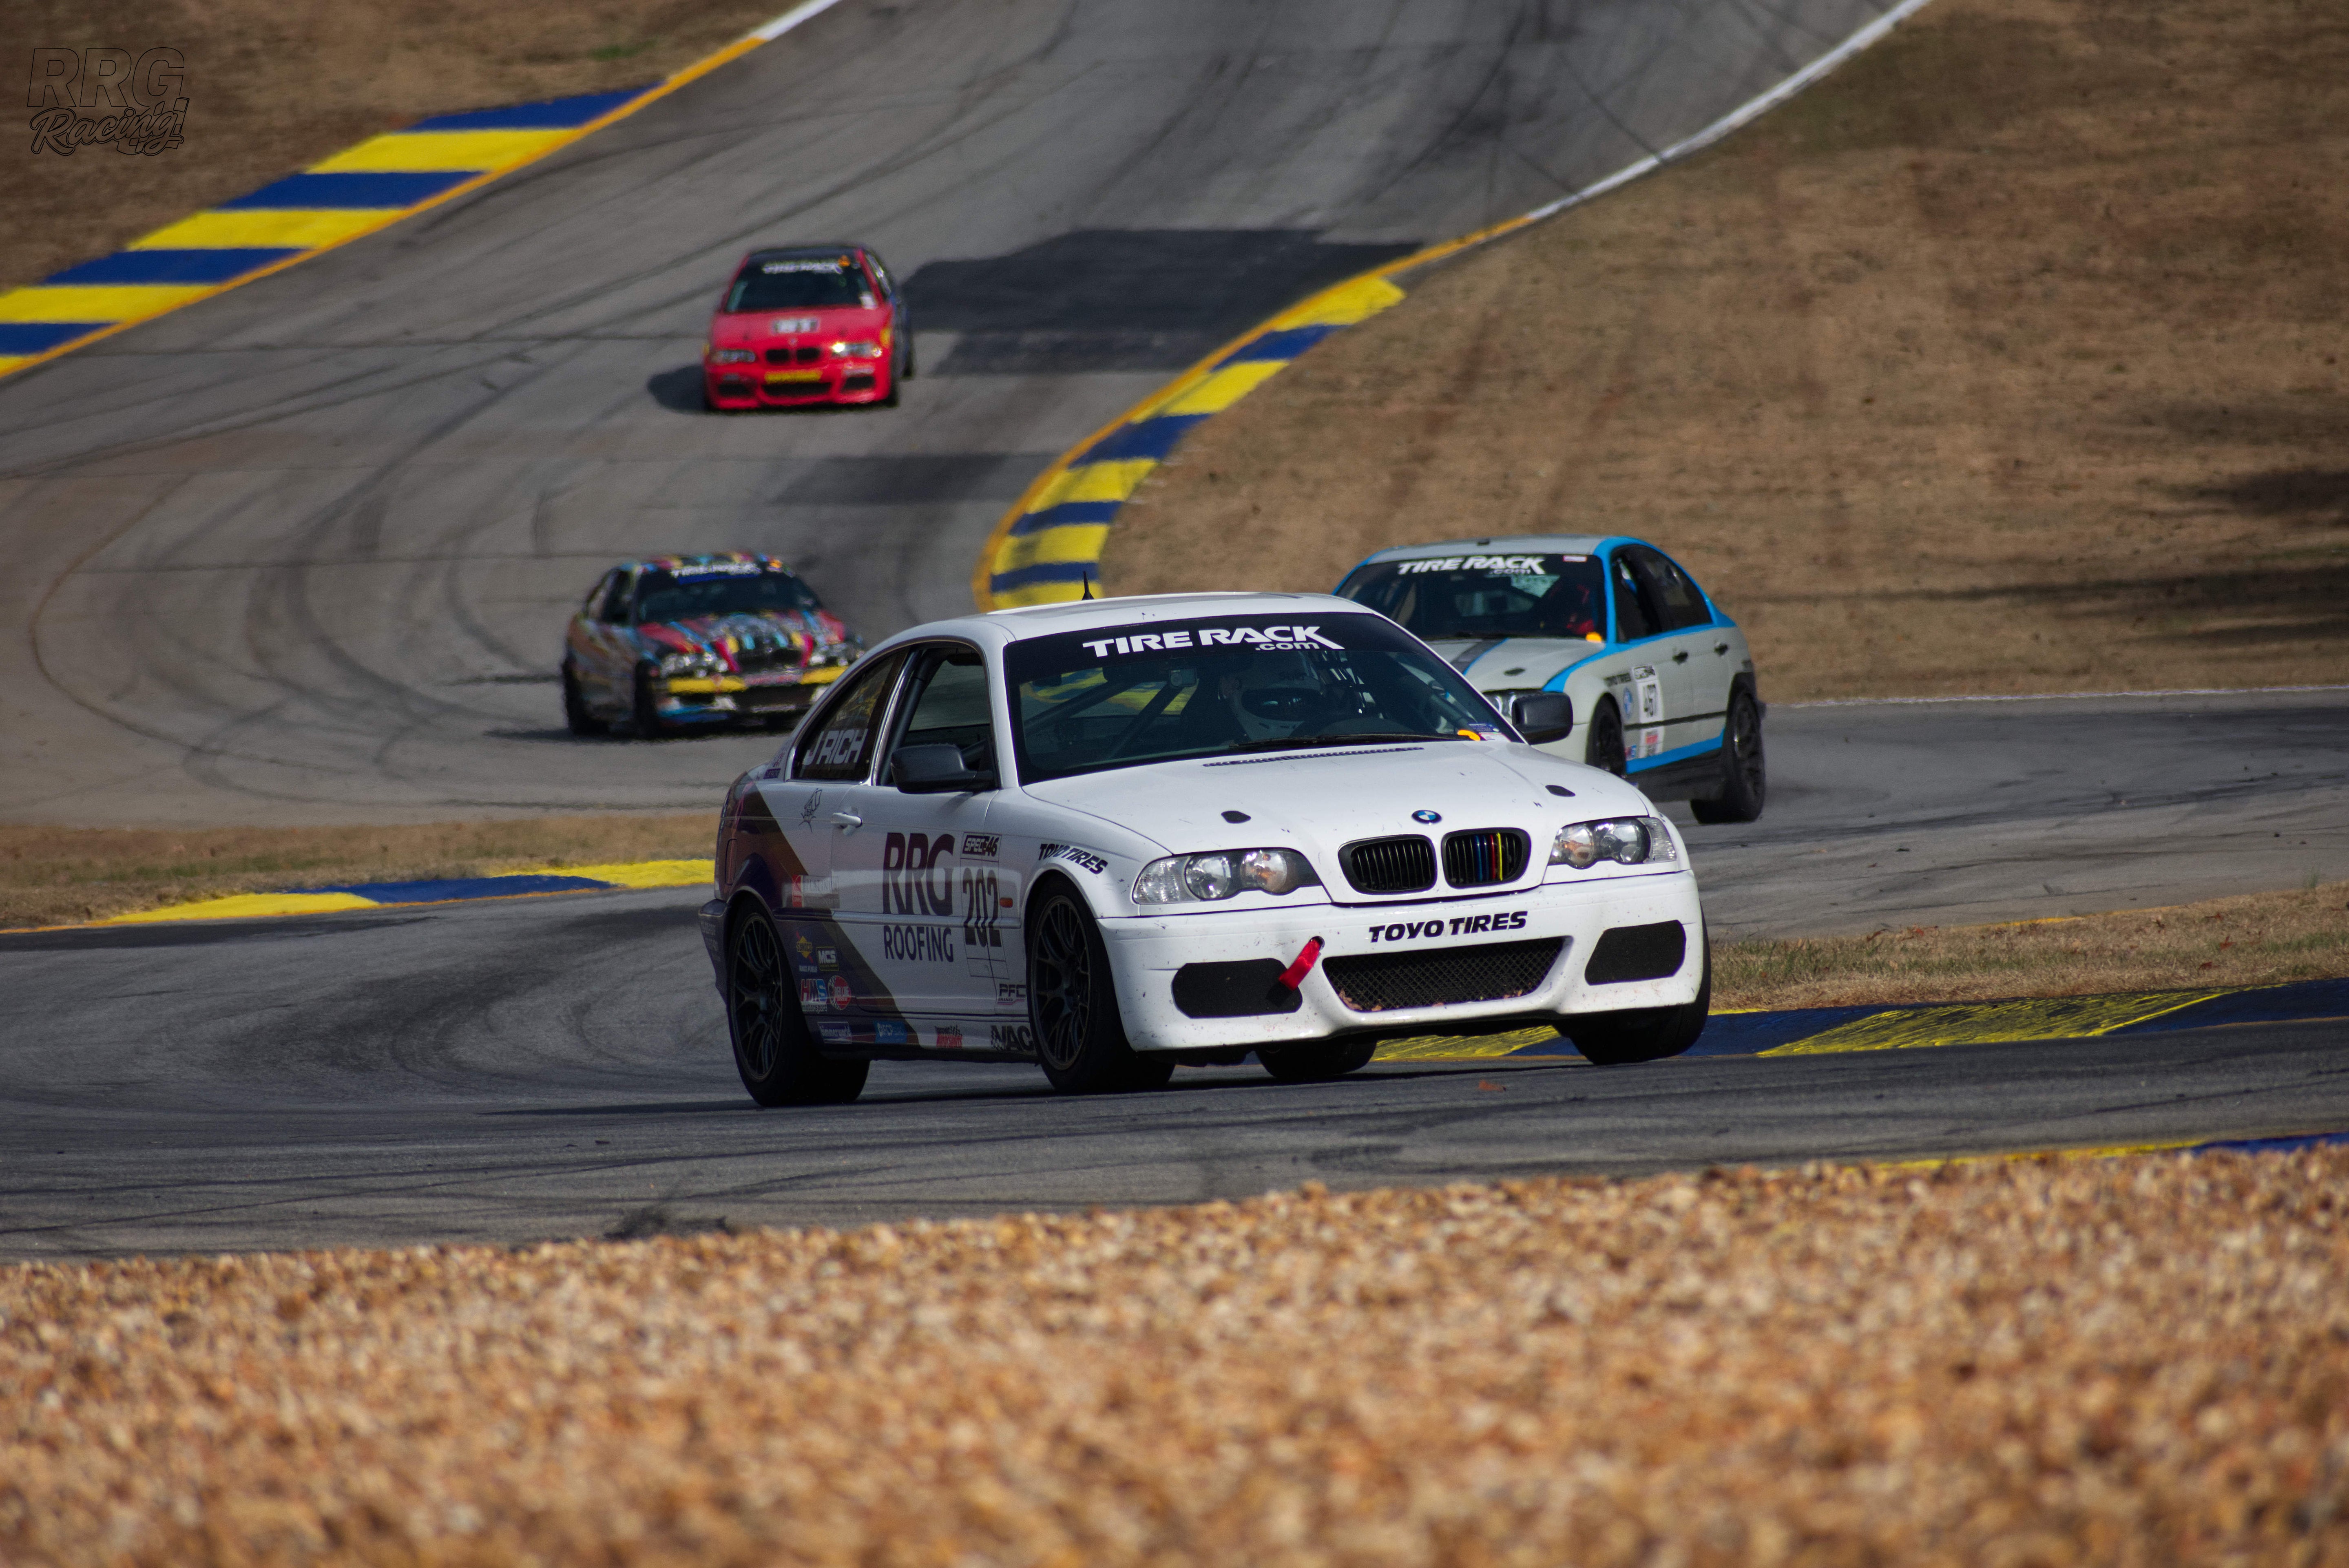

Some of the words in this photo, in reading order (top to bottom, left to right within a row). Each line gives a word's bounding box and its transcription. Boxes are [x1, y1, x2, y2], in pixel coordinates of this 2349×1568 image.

[1398, 557, 1465, 575] TIRE
[1462, 555, 1546, 575] RACK
[1083, 631, 1193, 658] TIRE
[1198, 626, 1345, 650] RACK
[1255, 641, 1320, 651] .com
[883, 832, 955, 916] RRG
[1039, 843, 1071, 860] TOYO
[1061, 847, 1108, 874] TIRES
[962, 867, 1002, 947] 202
[1369, 920, 1444, 943] TOYO
[1449, 911, 1528, 935] TIRES
[818, 950, 836, 964] MCS
[884, 925, 954, 962] ROOFING
[801, 979, 827, 1002] HMS
[999, 983, 1026, 998] PFC
